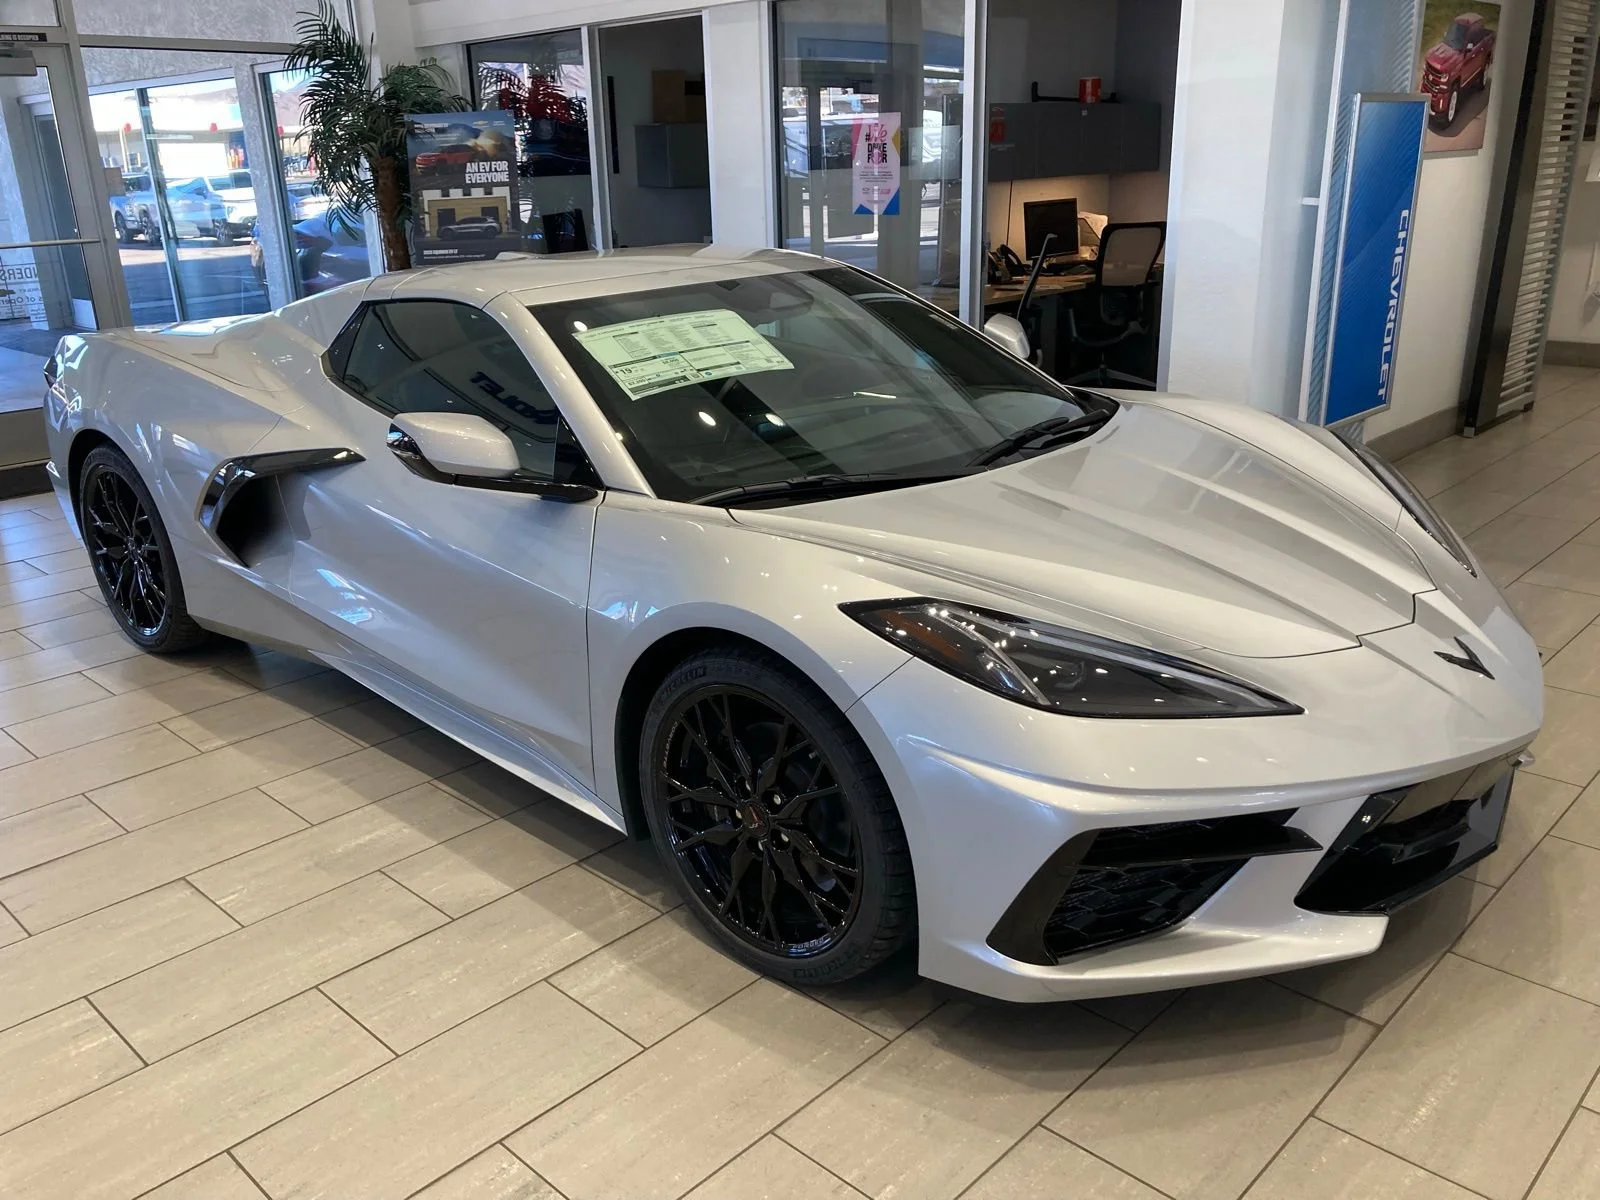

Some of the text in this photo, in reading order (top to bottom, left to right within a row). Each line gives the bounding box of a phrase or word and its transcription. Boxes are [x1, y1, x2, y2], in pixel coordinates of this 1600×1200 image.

[465, 160, 509, 173] AN EV FOR
[465, 172, 510, 184] EVERYONE
[1376, 208, 1411, 401] CHEVROLET
